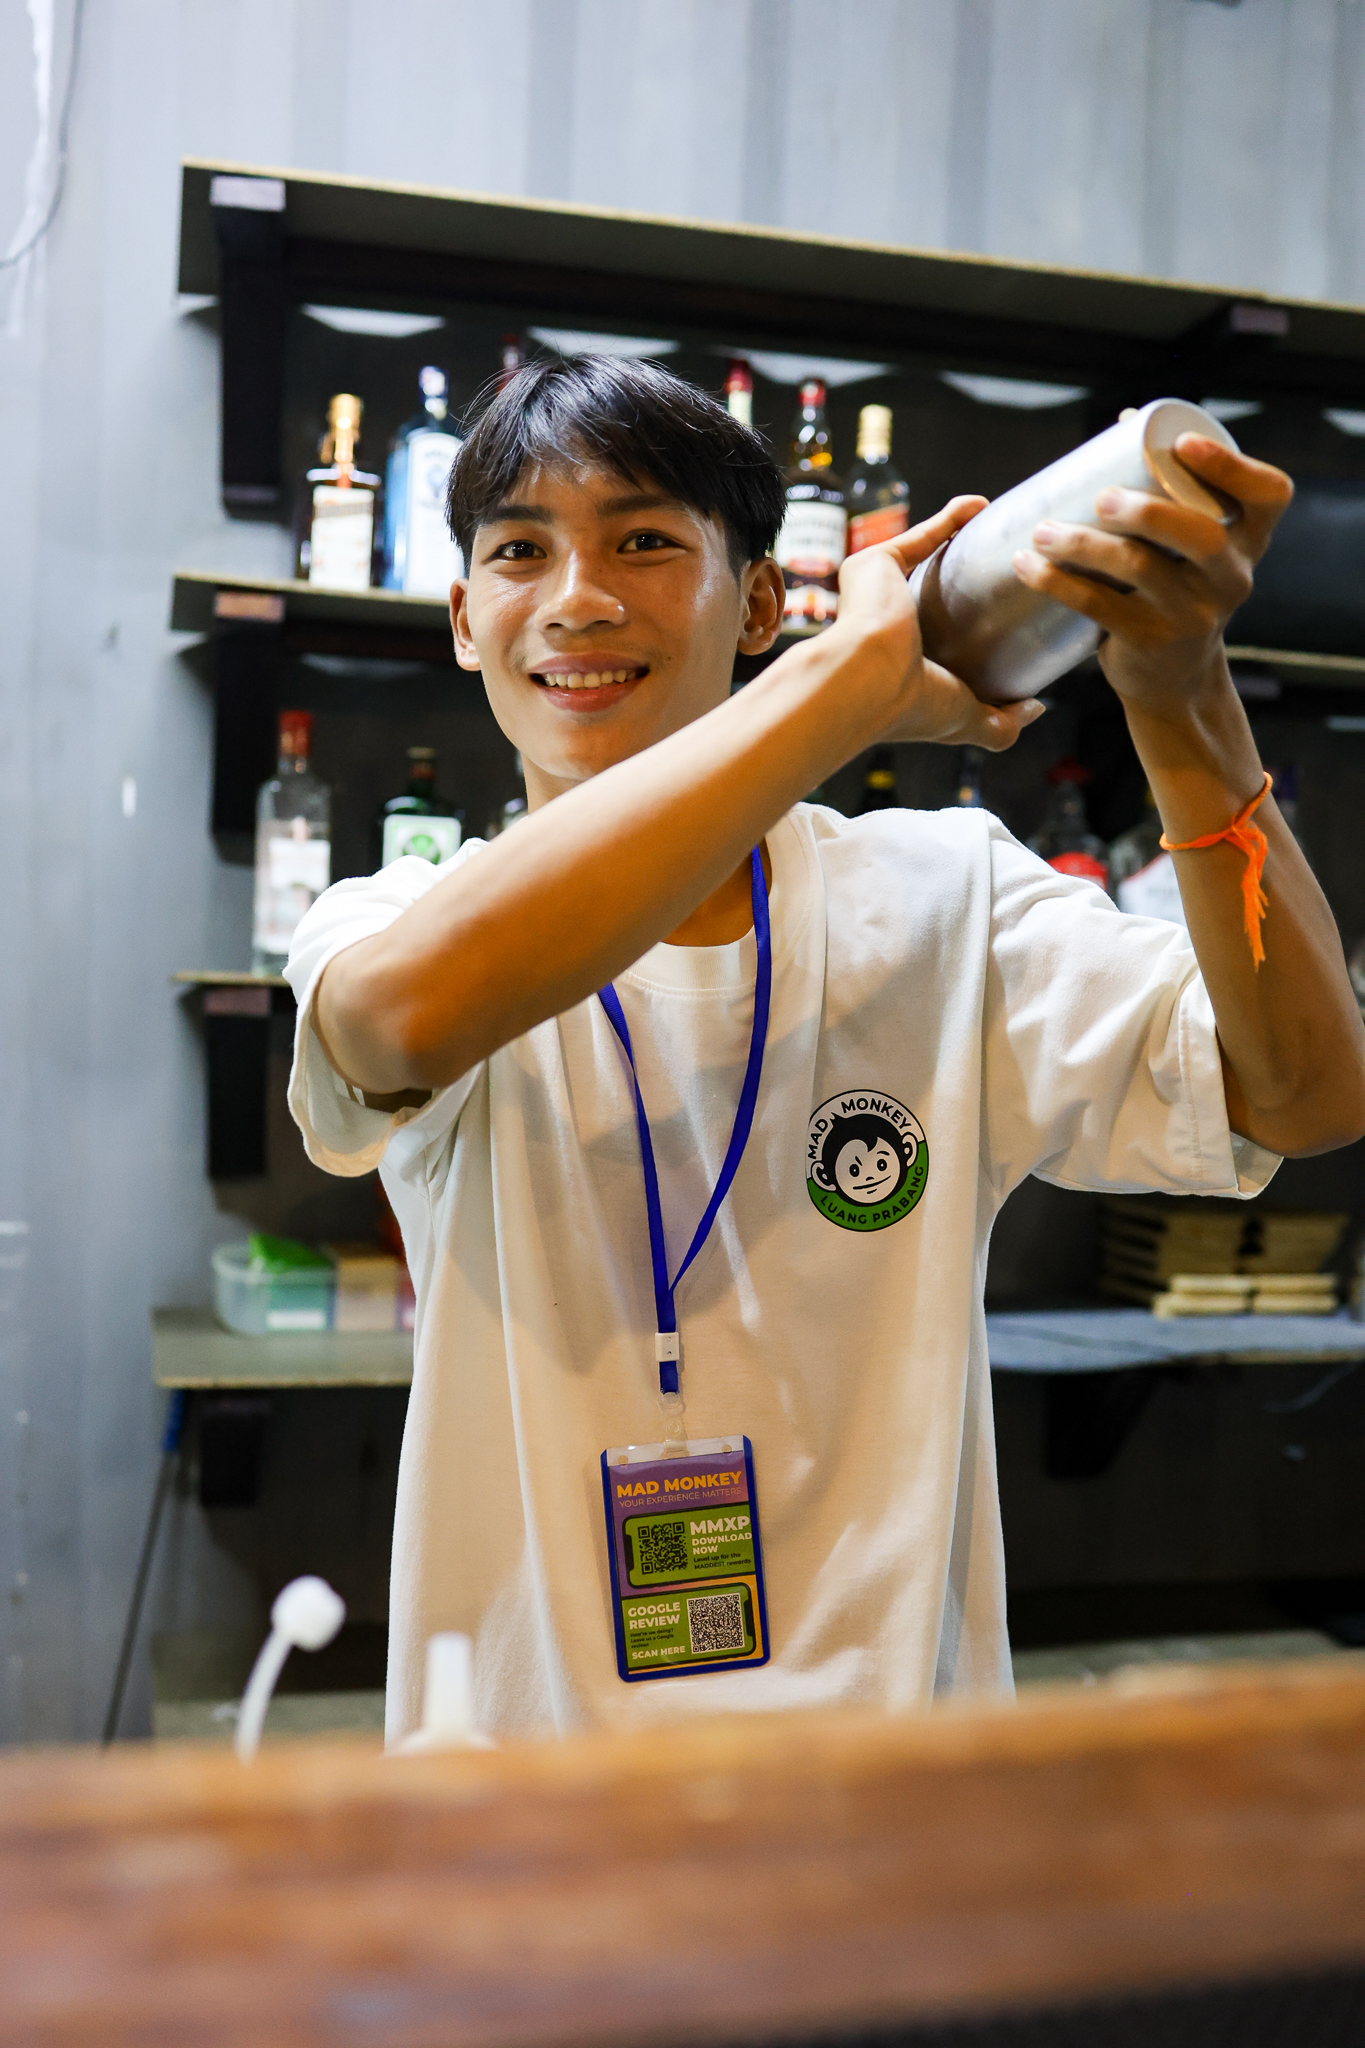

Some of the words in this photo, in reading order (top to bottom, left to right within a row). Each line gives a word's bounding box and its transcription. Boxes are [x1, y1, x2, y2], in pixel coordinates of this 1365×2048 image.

[808, 1118, 829, 1160] MAD
[840, 1097, 912, 1130] MONKEY
[820, 1195, 867, 1225] LUANG
[872, 1166, 924, 1223] PRABANG
[616, 1480, 660, 1498] MAD
[664, 1471, 742, 1492] MONKEY
[619, 1497, 645, 1508] YOUR
[646, 1491, 701, 1505] EXPERIENCE
[702, 1487, 742, 1499] MATTERS
[690, 1515, 750, 1535] MMXP
[692, 1532, 752, 1546] DOWNLOAD
[693, 1545, 718, 1555] NOW
[726, 1558, 751, 1566] rewards
[628, 1602, 681, 1617] GOOGLE
[629, 1614, 680, 1630] REVIEW
[632, 1649, 658, 1660] SCAN
[660, 1646, 686, 1656] HERE
